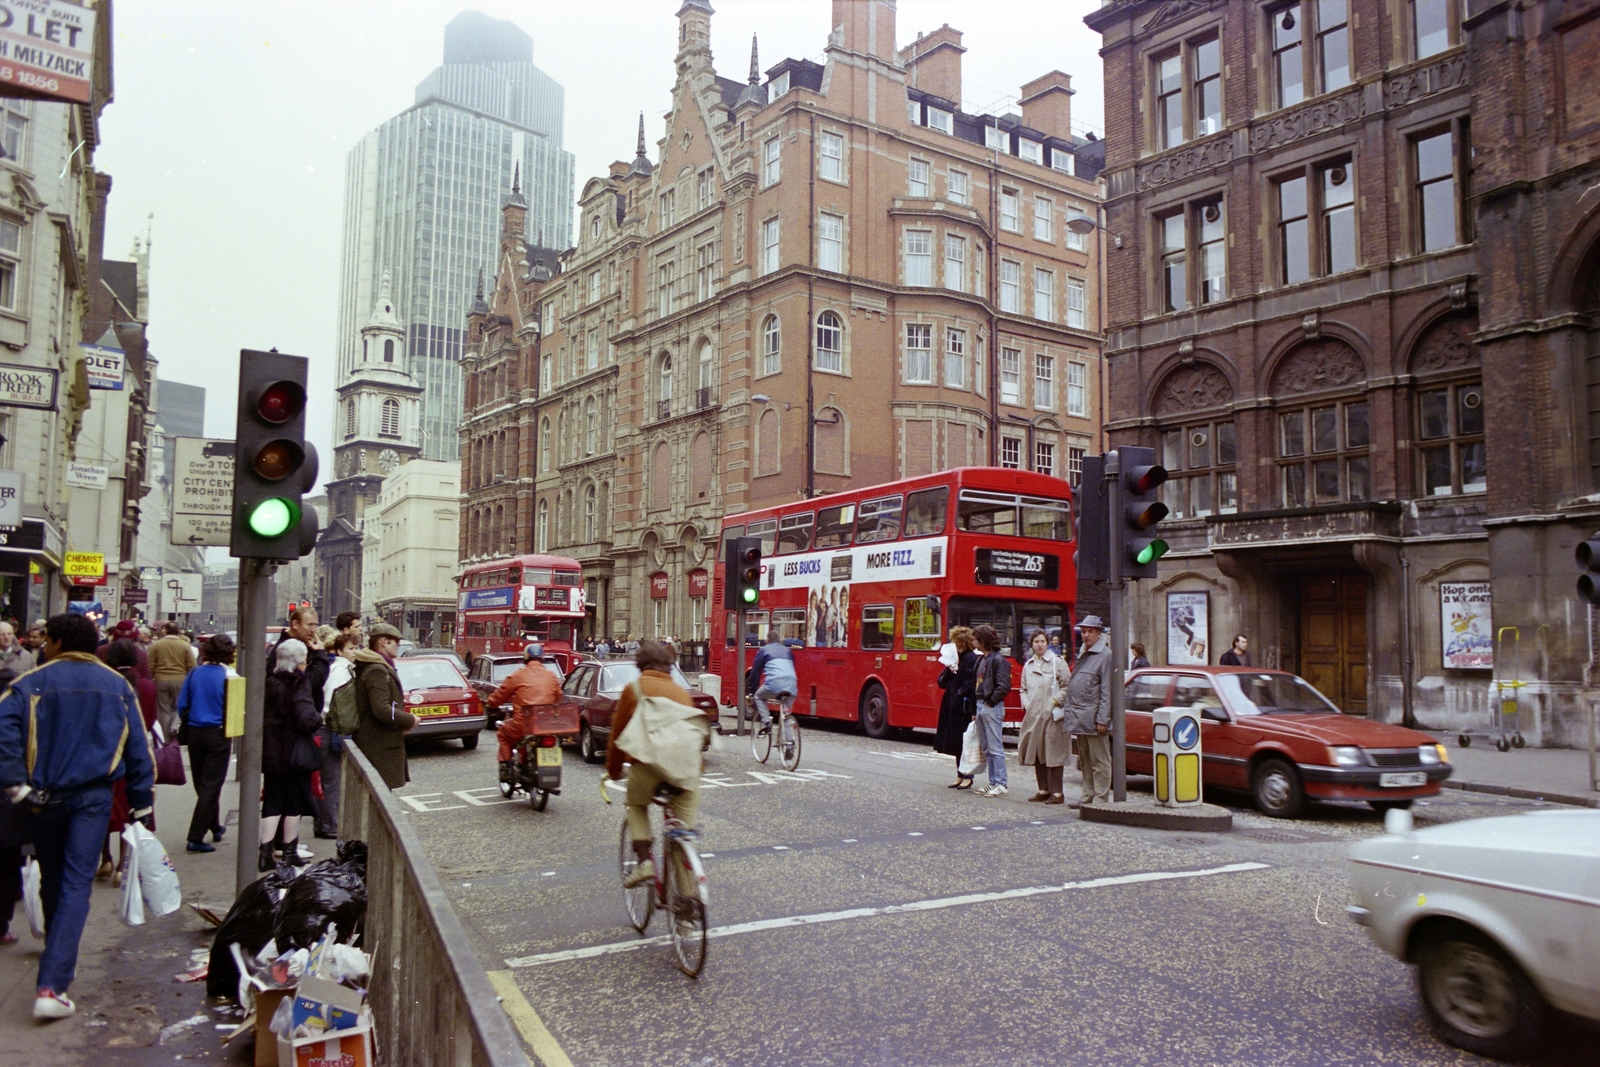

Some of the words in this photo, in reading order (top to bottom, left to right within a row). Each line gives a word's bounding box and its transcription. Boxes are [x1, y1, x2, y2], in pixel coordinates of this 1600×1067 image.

[51, 9, 82, 24] SUITE
[27, 13, 83, 48] LET
[14, 43, 85, 78] MELZACK
[16, 70, 59, 92] 1856
[95, 357, 121, 370] LET
[70, 463, 106, 475] Jonathan
[208, 460, 215, 468] 3
[75, 471, 98, 481] Wren
[183, 477, 207, 486] CITY
[182, 502, 222, 510] THROUGH
[195, 526, 211, 534] Ring
[66, 554, 103, 563] CHEMIST
[866, 552, 891, 570] MORE
[892, 549, 915, 567] FIZZ.
[70, 564, 98, 573] OPEN
[784, 561, 798, 577] LESS
[799, 558, 821, 575] BUCKS
[1442, 585, 1466, 595] Hop
[1443, 595, 1450, 603] a
[304, 1001, 315, 1010] KP
